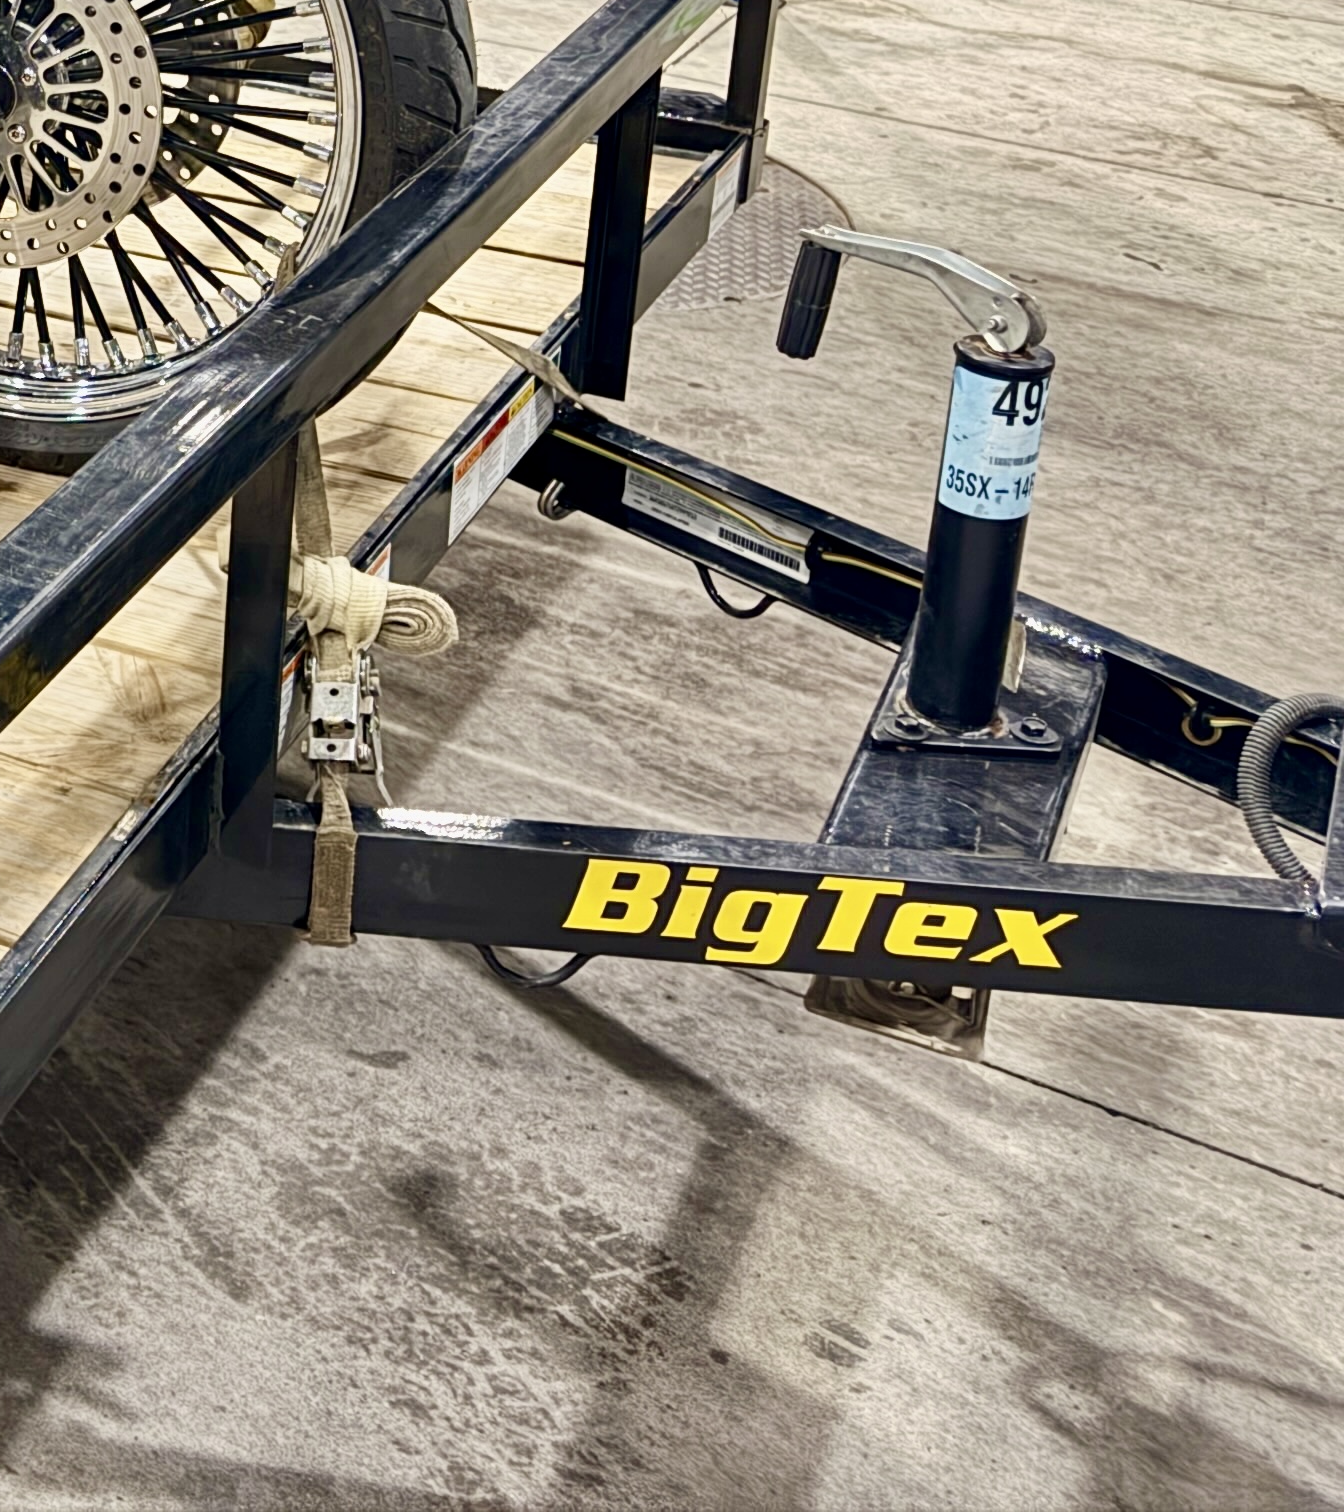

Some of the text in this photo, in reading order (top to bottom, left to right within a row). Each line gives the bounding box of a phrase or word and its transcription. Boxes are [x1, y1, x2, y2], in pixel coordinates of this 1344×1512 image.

[992, 377, 1050, 426] 49
[946, 464, 993, 500] 35SX
[561, 857, 1080, 969] BigTex
